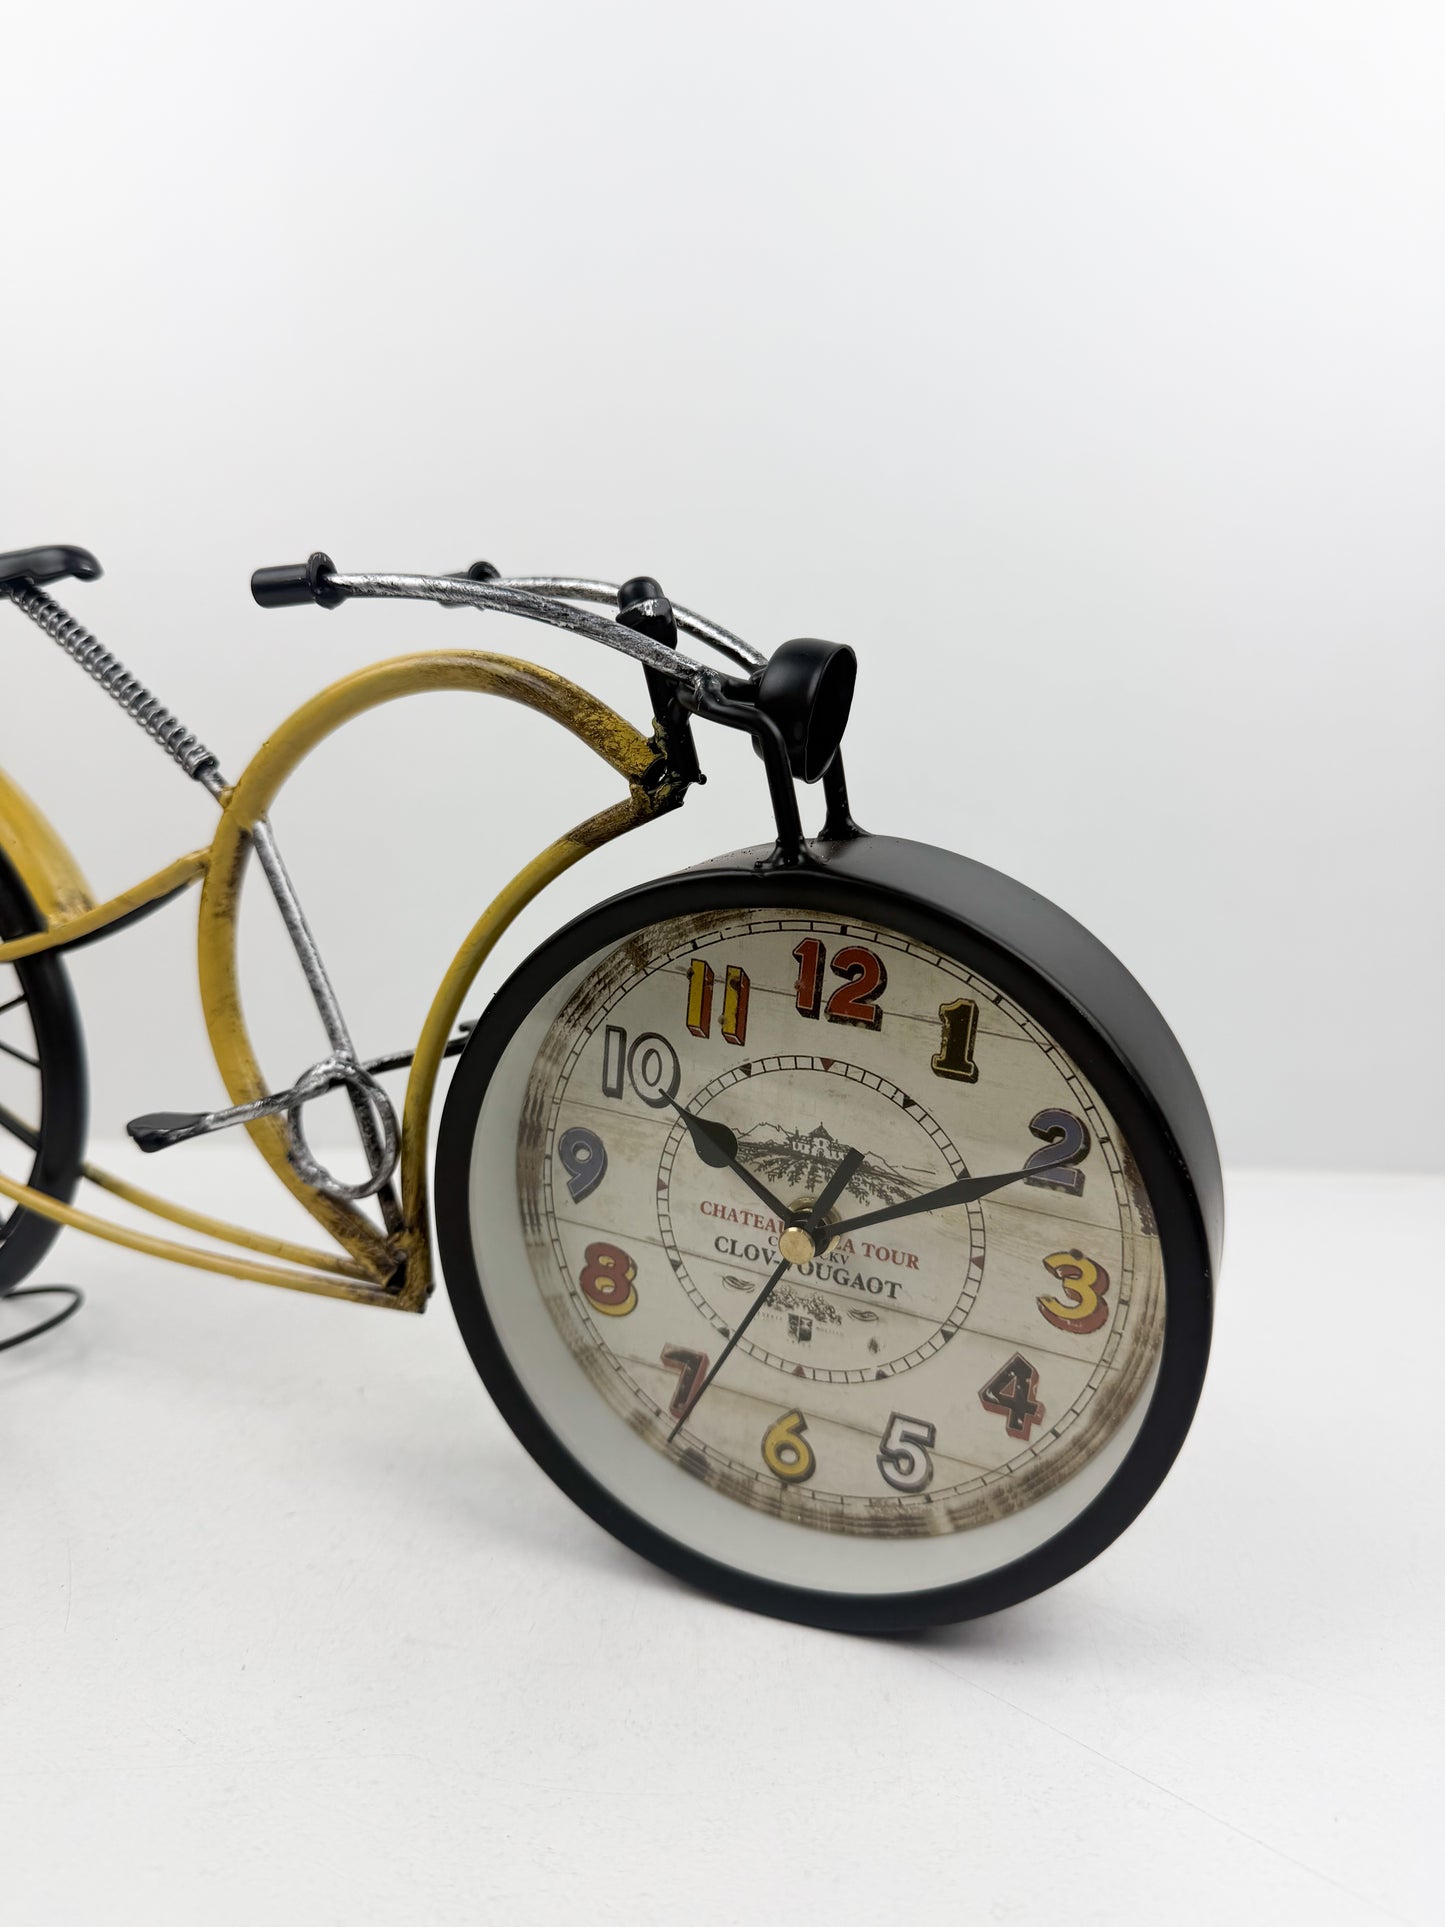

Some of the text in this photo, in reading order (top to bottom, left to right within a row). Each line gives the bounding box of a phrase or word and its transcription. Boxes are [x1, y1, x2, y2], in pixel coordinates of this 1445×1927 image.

[686, 959, 750, 1045] 11
[791, 937, 887, 1031] 12
[602, 1024, 681, 1108] 10
[932, 998, 979, 1083] 1
[559, 1127, 608, 1203] 9
[1021, 1108, 1092, 1196] 2
[580, 1242, 638, 1318] 8
[714, 1236, 902, 1299] CLOV-OUGAOT
[862, 1242, 920, 1270] TOUR
[1037, 1249, 1110, 1334] 3
[661, 1343, 710, 1419] 7
[977, 1352, 1046, 1441] 4
[761, 1408, 816, 1483] 6
[876, 1411, 937, 1494] 5
